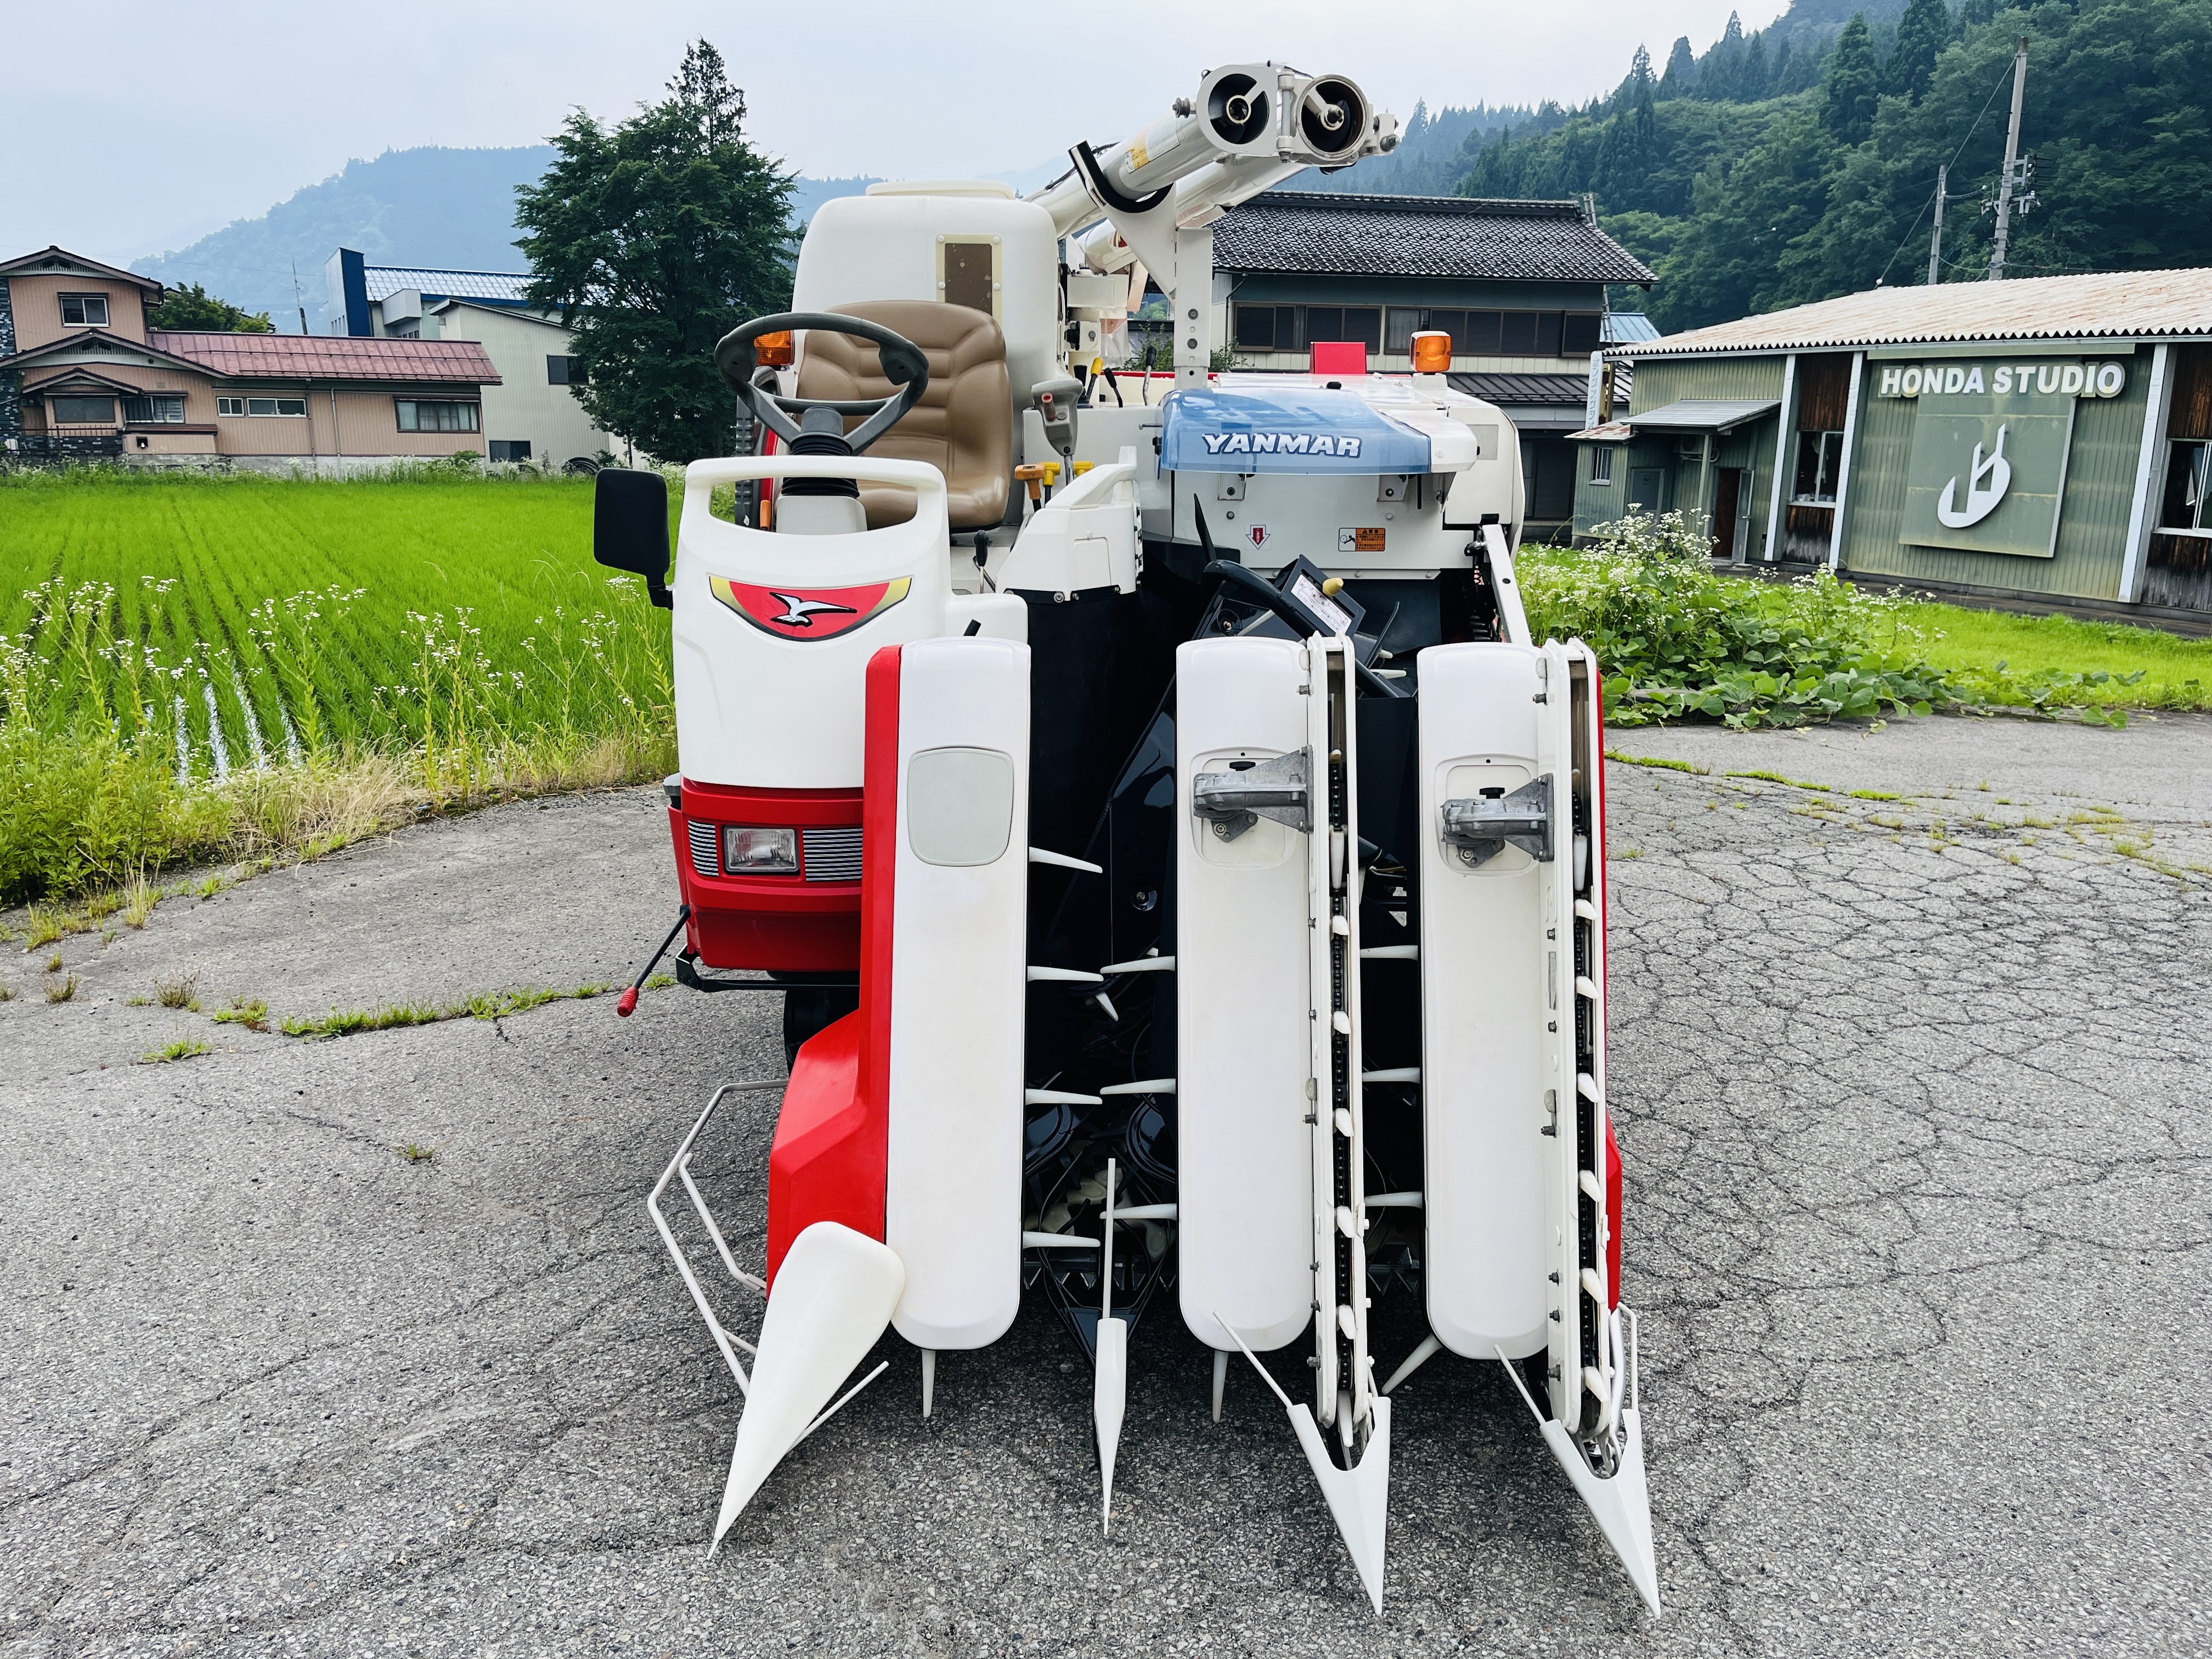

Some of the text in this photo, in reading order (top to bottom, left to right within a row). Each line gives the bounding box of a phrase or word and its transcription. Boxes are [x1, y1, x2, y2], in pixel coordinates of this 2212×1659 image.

[1880, 364, 2123, 395] HONDA STUDIO
[1201, 432, 1362, 458] YANMAR
